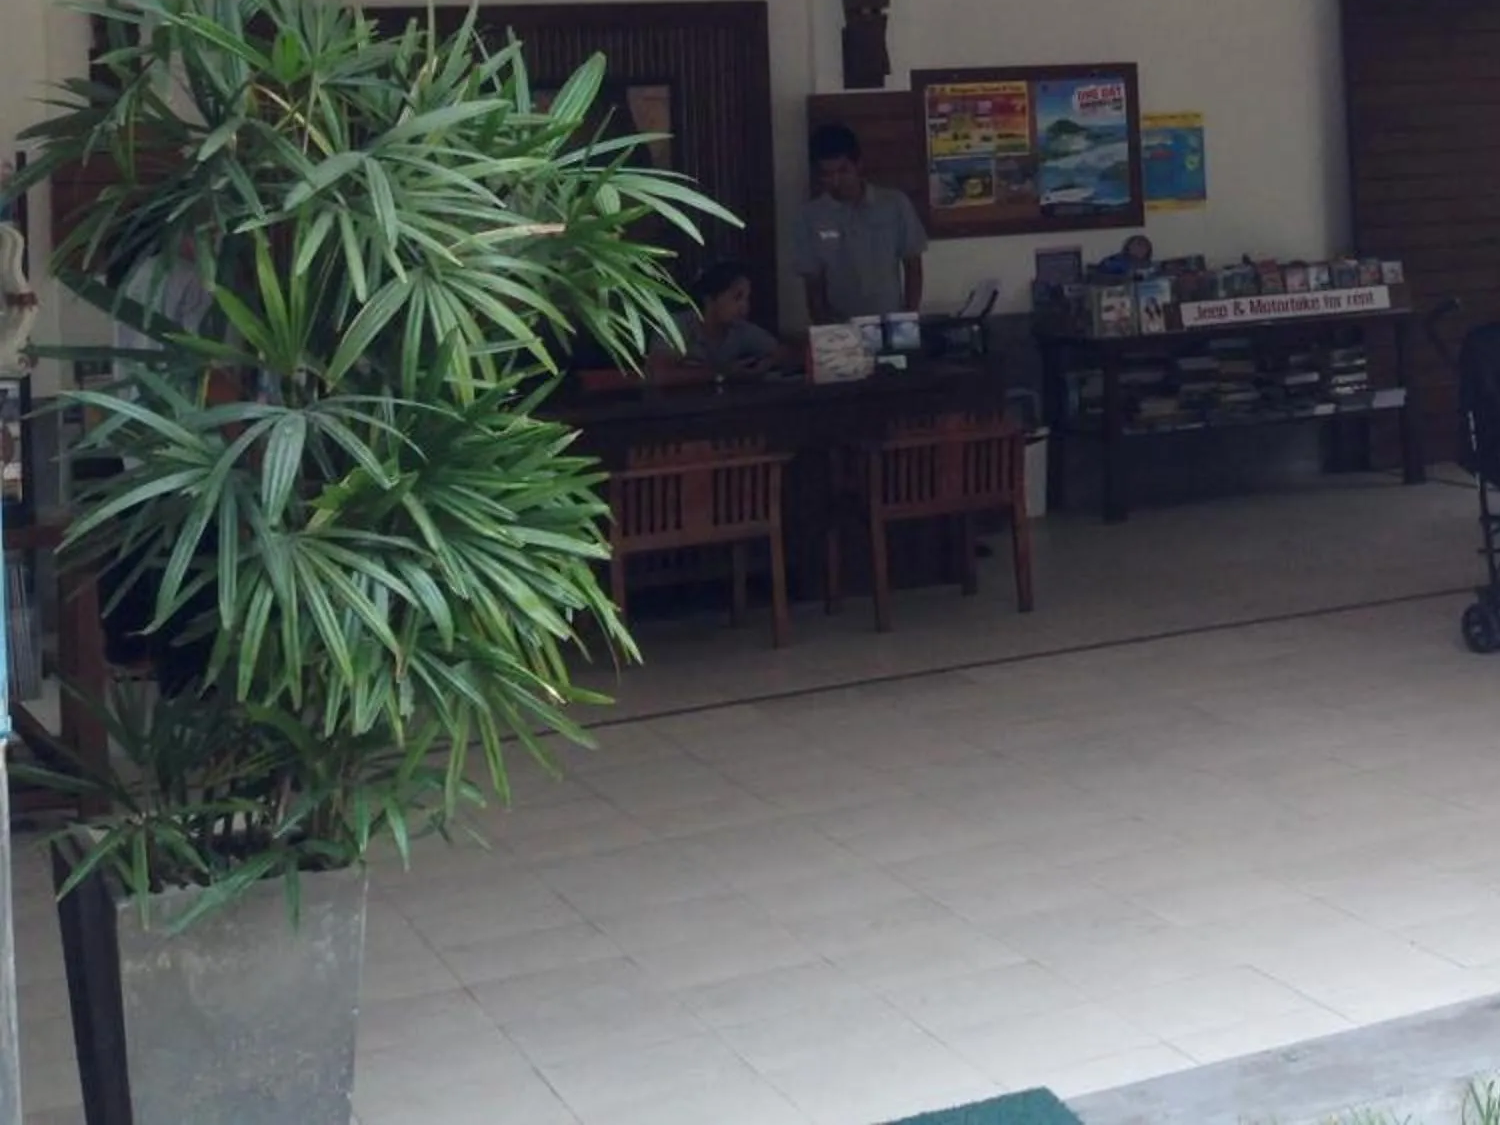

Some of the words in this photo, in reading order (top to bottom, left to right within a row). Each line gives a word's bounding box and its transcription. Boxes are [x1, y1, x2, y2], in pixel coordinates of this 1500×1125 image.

[1194, 305, 1227, 322] Jeep
[1233, 301, 1245, 316] &
[1322, 293, 1342, 310] for
[1346, 290, 1375, 308] rent
